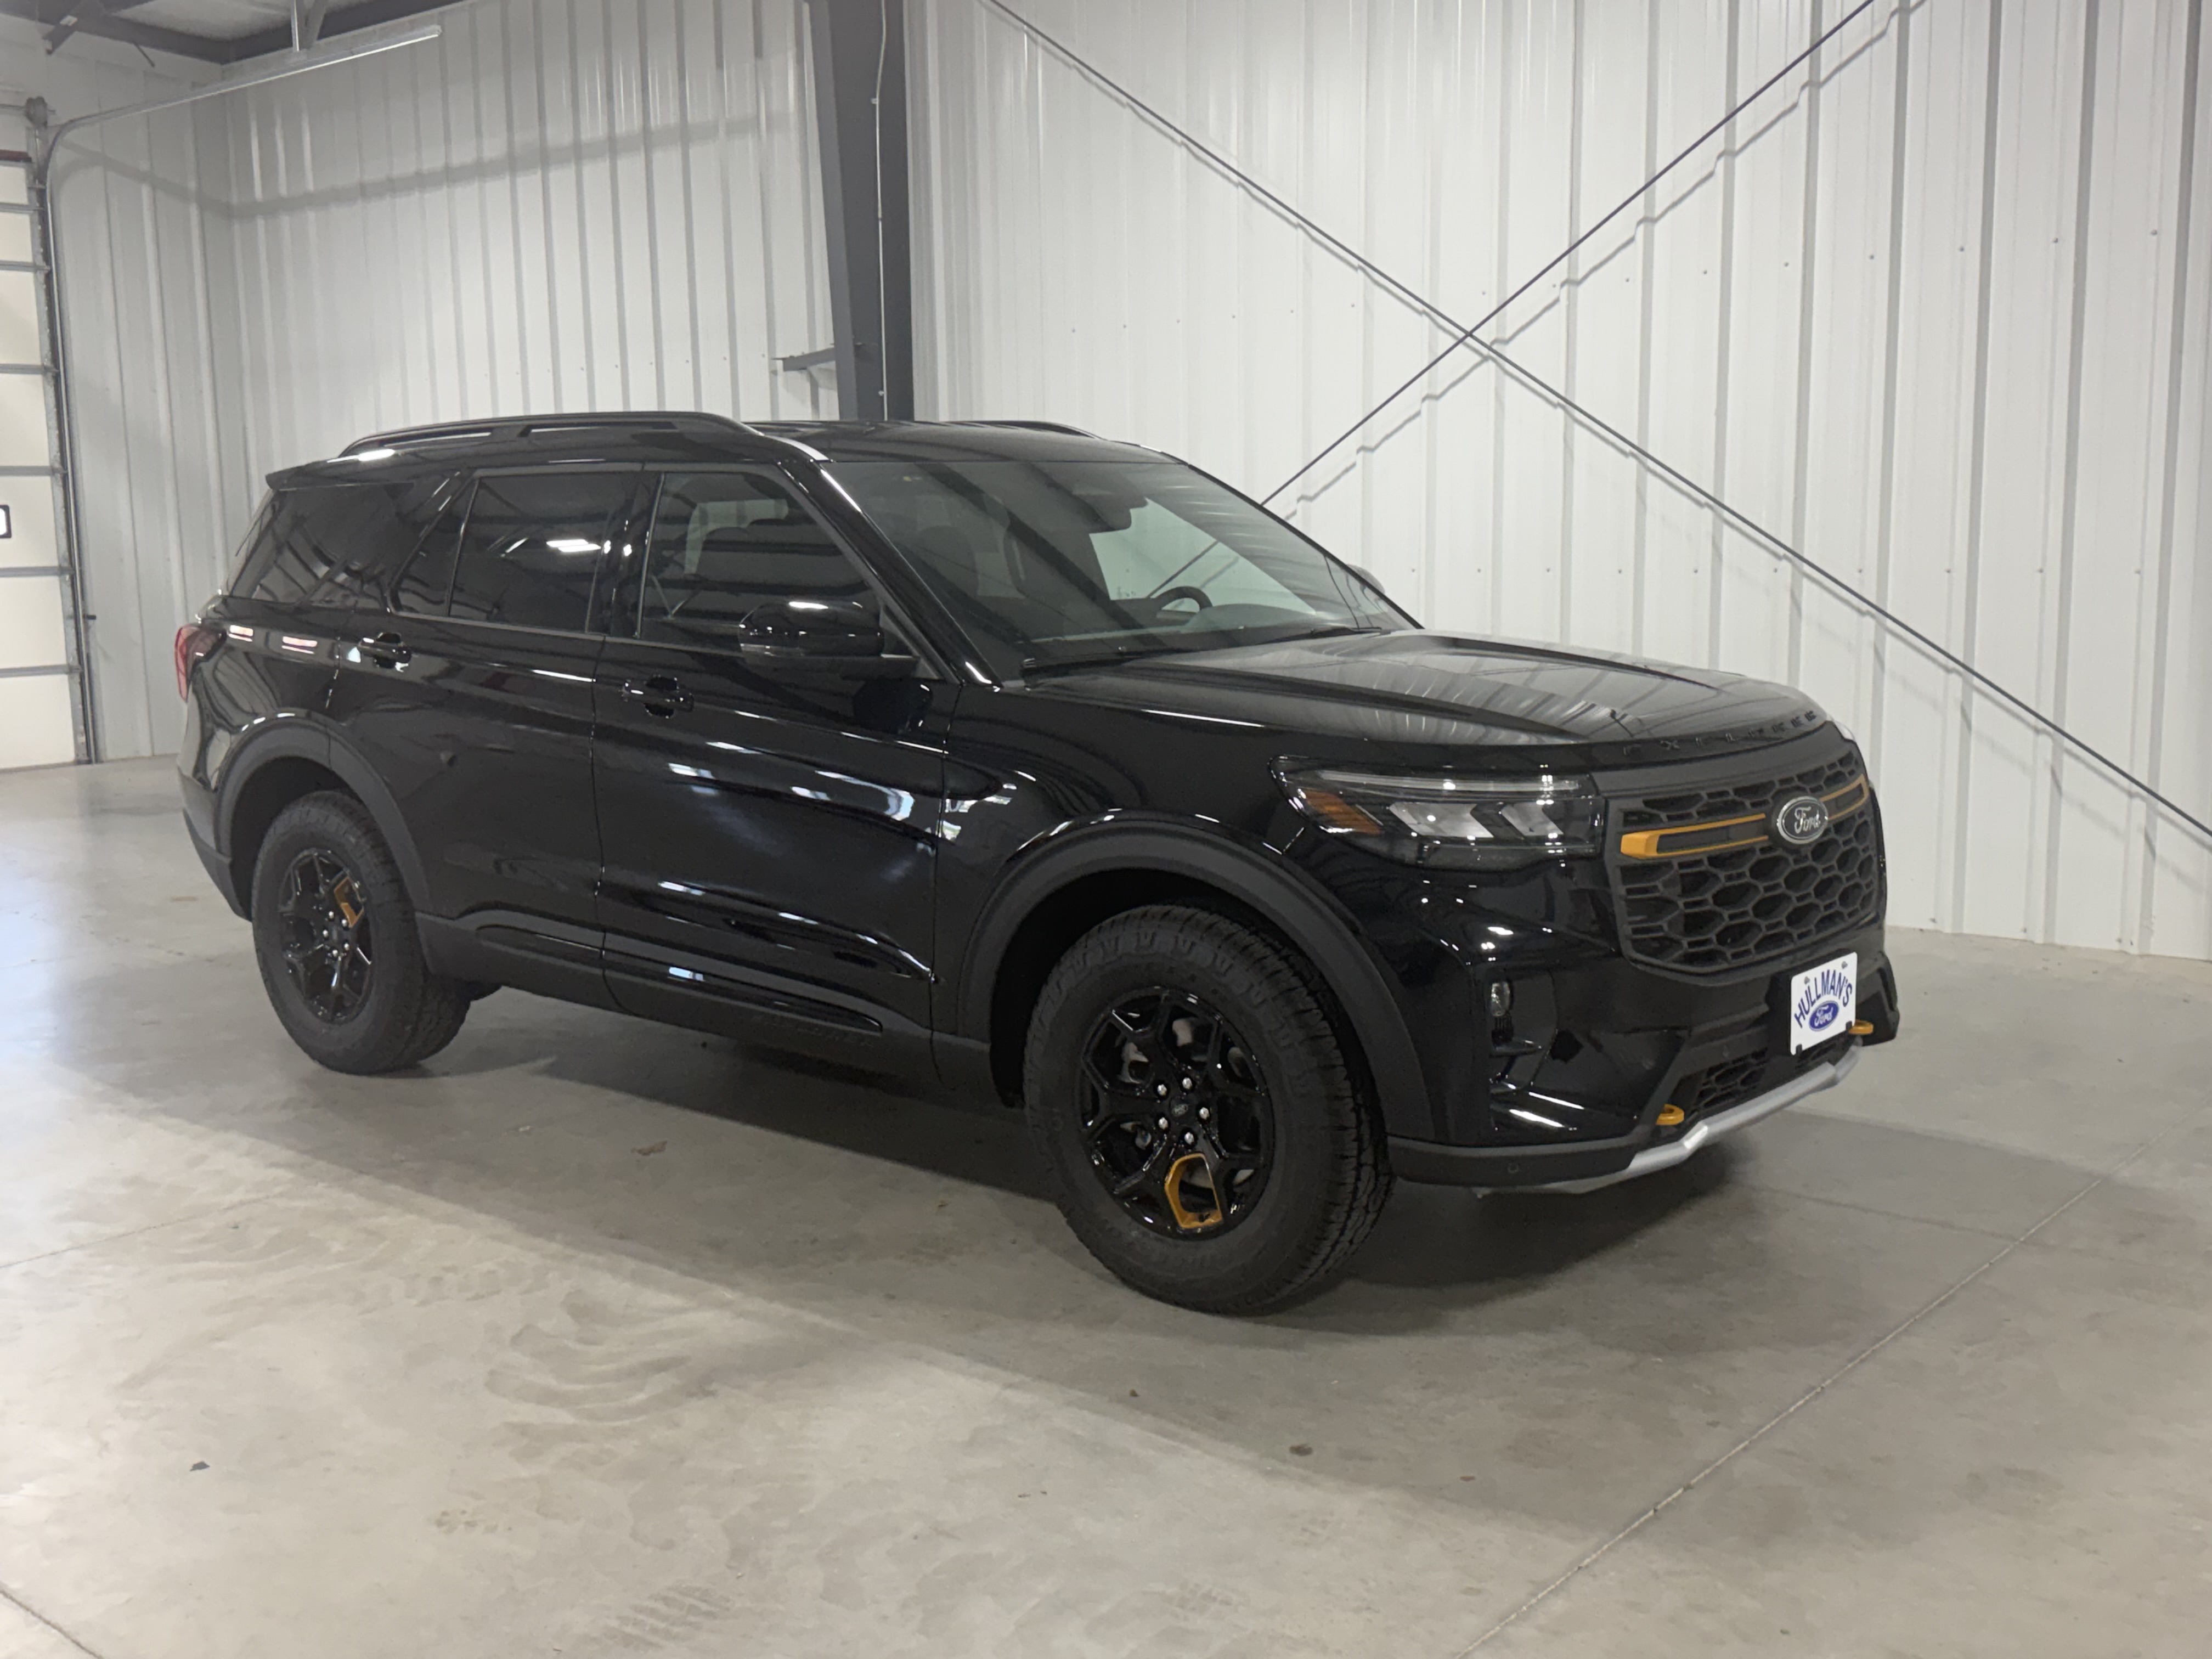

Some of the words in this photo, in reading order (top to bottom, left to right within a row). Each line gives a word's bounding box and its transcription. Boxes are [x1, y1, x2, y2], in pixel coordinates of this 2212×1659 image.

[1795, 806, 1821, 834] Ford
[1794, 969, 1852, 1029] HULLMAN'S
[1814, 1005, 1833, 1026] Ford
